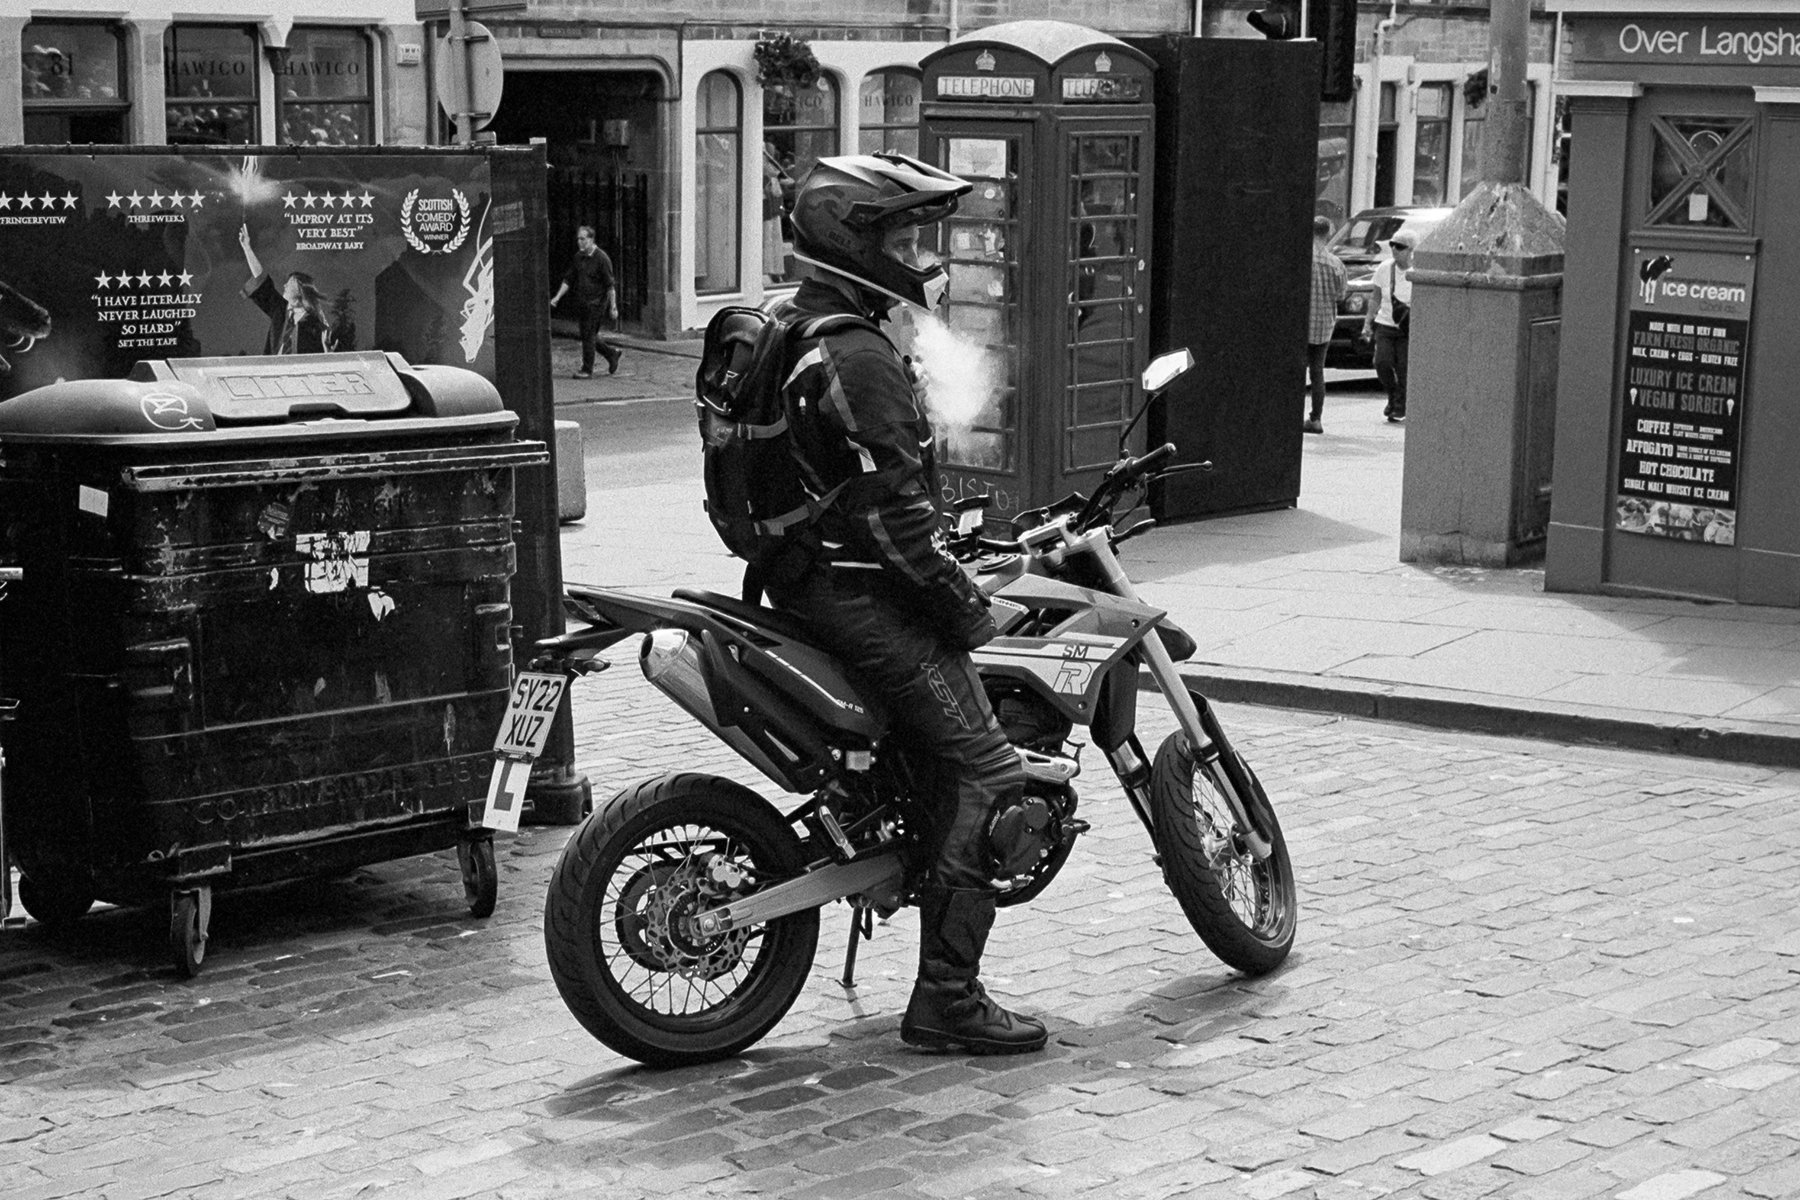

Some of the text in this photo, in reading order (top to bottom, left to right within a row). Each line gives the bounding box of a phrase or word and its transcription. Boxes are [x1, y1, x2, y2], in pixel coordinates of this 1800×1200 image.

[1619, 24, 1689, 53] Over
[283, 61, 360, 76] HAWICO
[941, 77, 1033, 97] TELEPHONE
[418, 199, 453, 211] SCOTTISH
[0, 216, 67, 225] FRINGEREVIEW
[127, 215, 185, 223] THREEWEEKS
[284, 213, 374, 224] “IMPROV AT ITS
[415, 212, 457, 222] COMEDY
[298, 226, 364, 238] VERY BEST”
[419, 222, 453, 232] AWARD
[423, 233, 450, 241] WINNER
[296, 242, 364, 251] BROADWAY BABY
[105, 295, 137, 306] HAVE
[140, 293, 202, 305] LITERALLY
[1690, 284, 1746, 302] cream
[98, 308, 197, 322] NEVER LAUGHED
[121, 320, 181, 335] SO HARD”
[118, 337, 178, 348] SET THE TAPE
[1633, 331, 1740, 355] FARM FRESH ORGANIC
[217, 371, 375, 400] LITTER
[1630, 367, 1737, 396] LUXURY ICE CREAM
[1640, 388, 1725, 415] VEGAN SORBET
[1637, 418, 1671, 436] COFFEE
[1626, 438, 1674, 457] AFFOGATO
[1639, 460, 1715, 483] HOT CHOCOLATE
[1624, 478, 1730, 502] SINGLE MALT WHISKY ICE CREAM
[1063, 644, 1089, 660] SM
[512, 678, 562, 712] SY22
[920, 662, 972, 730] RST
[504, 714, 545, 748] XUZ
[493, 759, 515, 812] L
